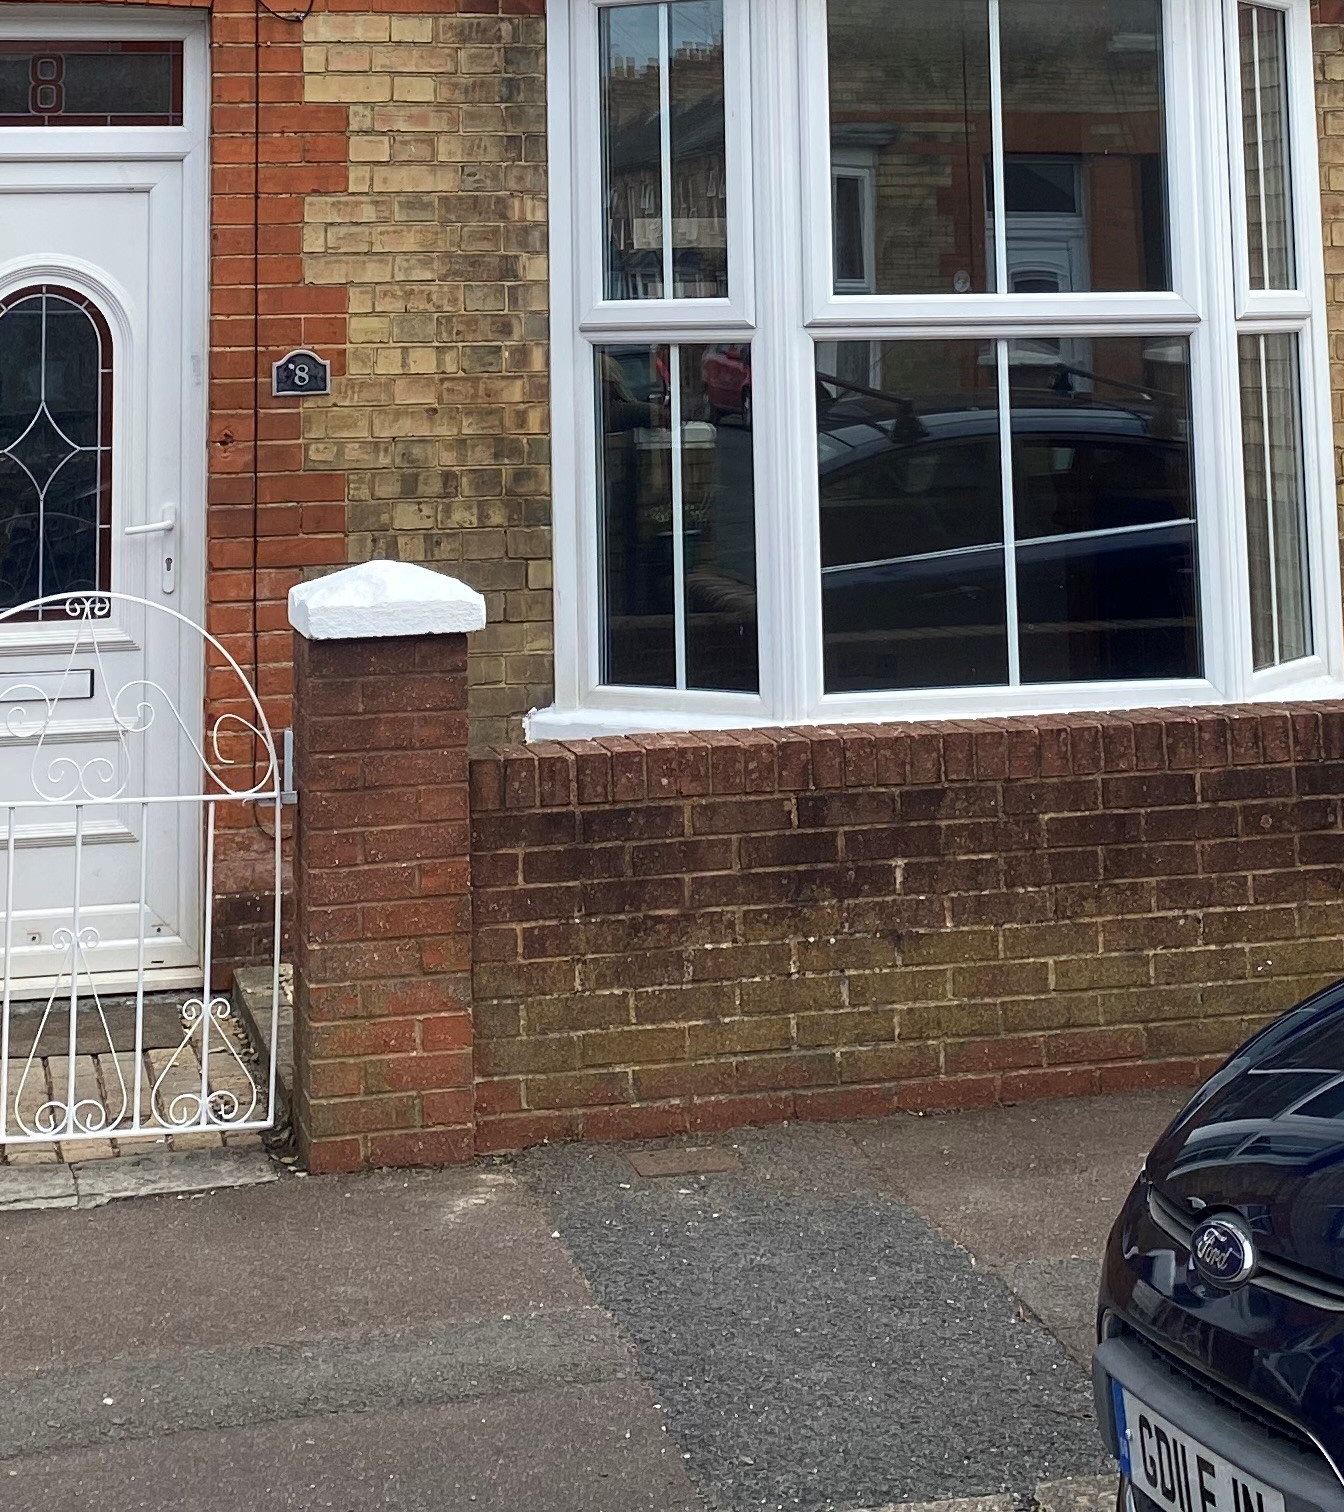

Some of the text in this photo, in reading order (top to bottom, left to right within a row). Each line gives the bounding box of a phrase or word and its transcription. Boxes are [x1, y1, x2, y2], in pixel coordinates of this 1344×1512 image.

[29, 52, 65, 116] 8
[294, 364, 309, 386] 8
[1196, 1227, 1236, 1271] Ford
